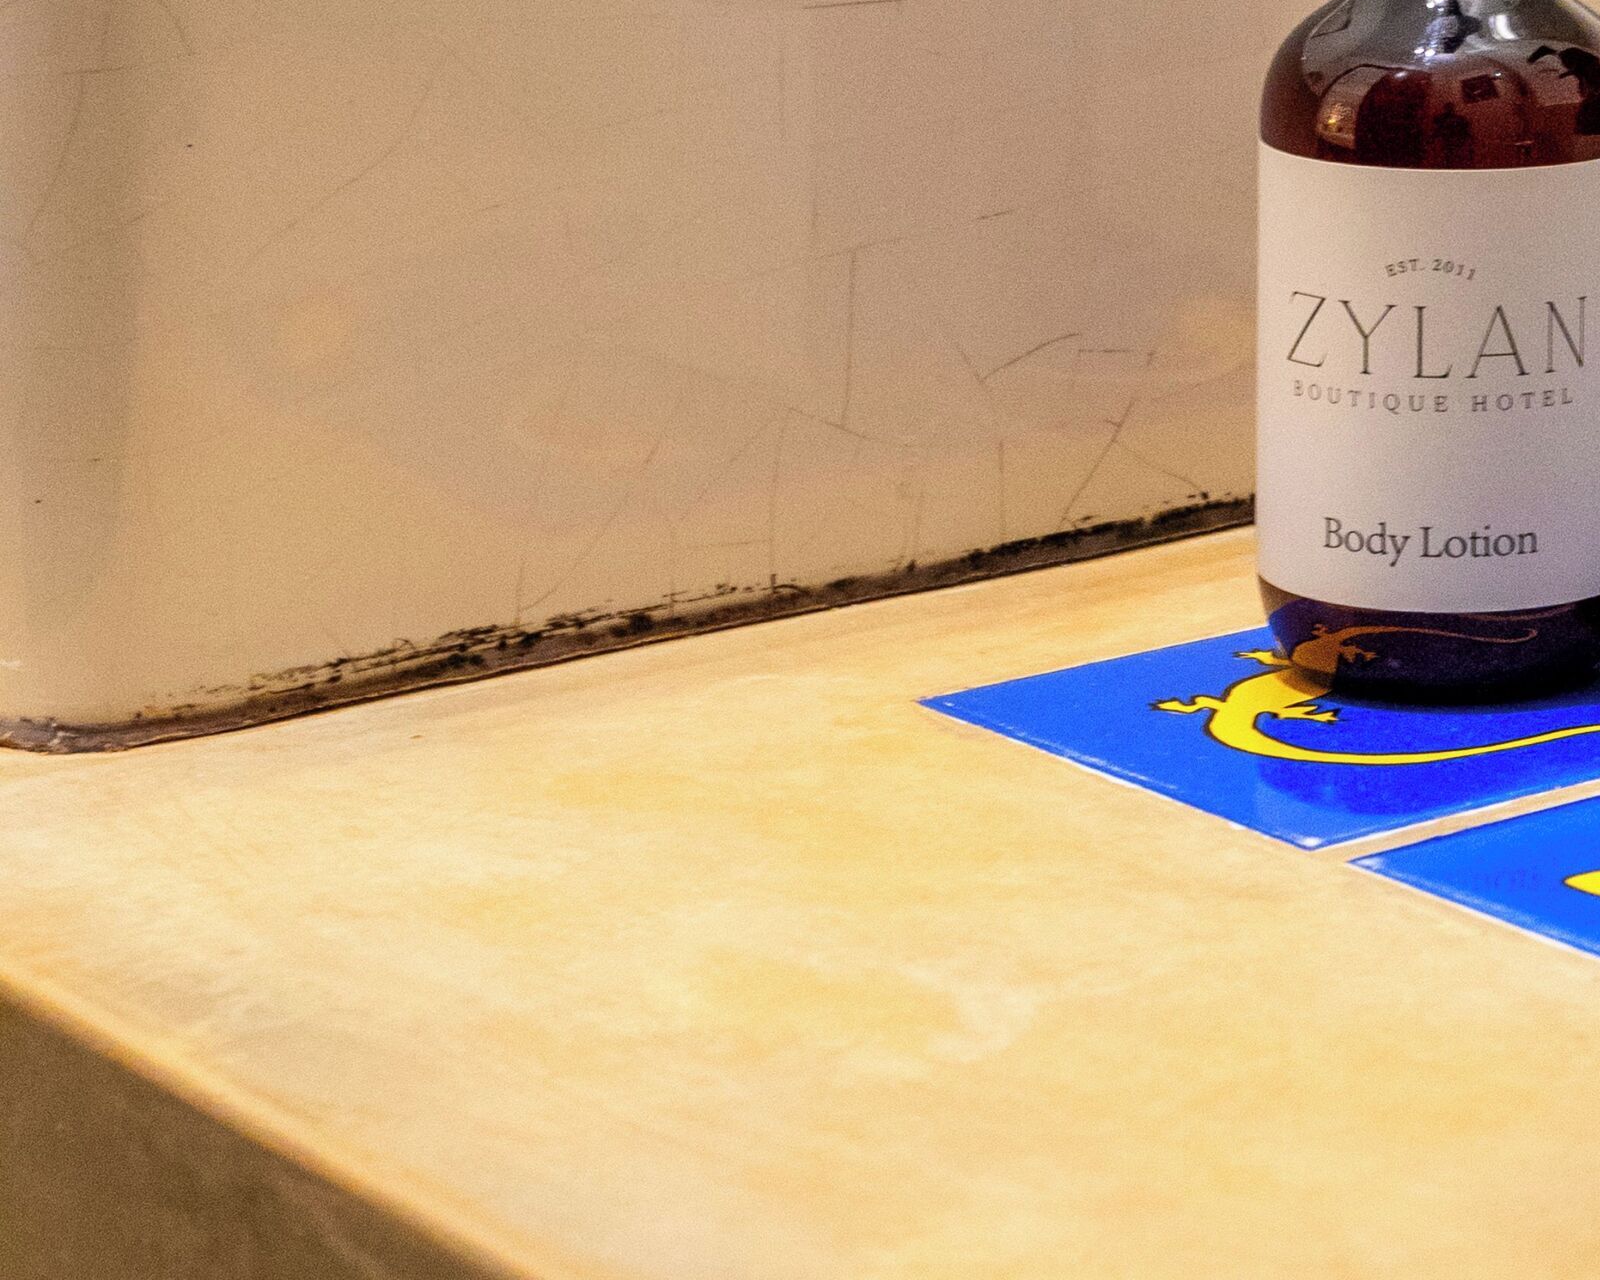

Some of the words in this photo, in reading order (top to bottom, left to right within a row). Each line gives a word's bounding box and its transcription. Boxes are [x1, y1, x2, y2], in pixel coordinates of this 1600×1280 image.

[1385, 259, 1426, 278] EST.
[1432, 258, 1476, 281] 2011
[1287, 291, 1587, 379] ZYLAN
[1294, 380, 1448, 415] BOUTIQUE
[1471, 388, 1573, 413] HOTEL
[1324, 516, 1411, 567] Body
[1420, 524, 1539, 558] Lotion
